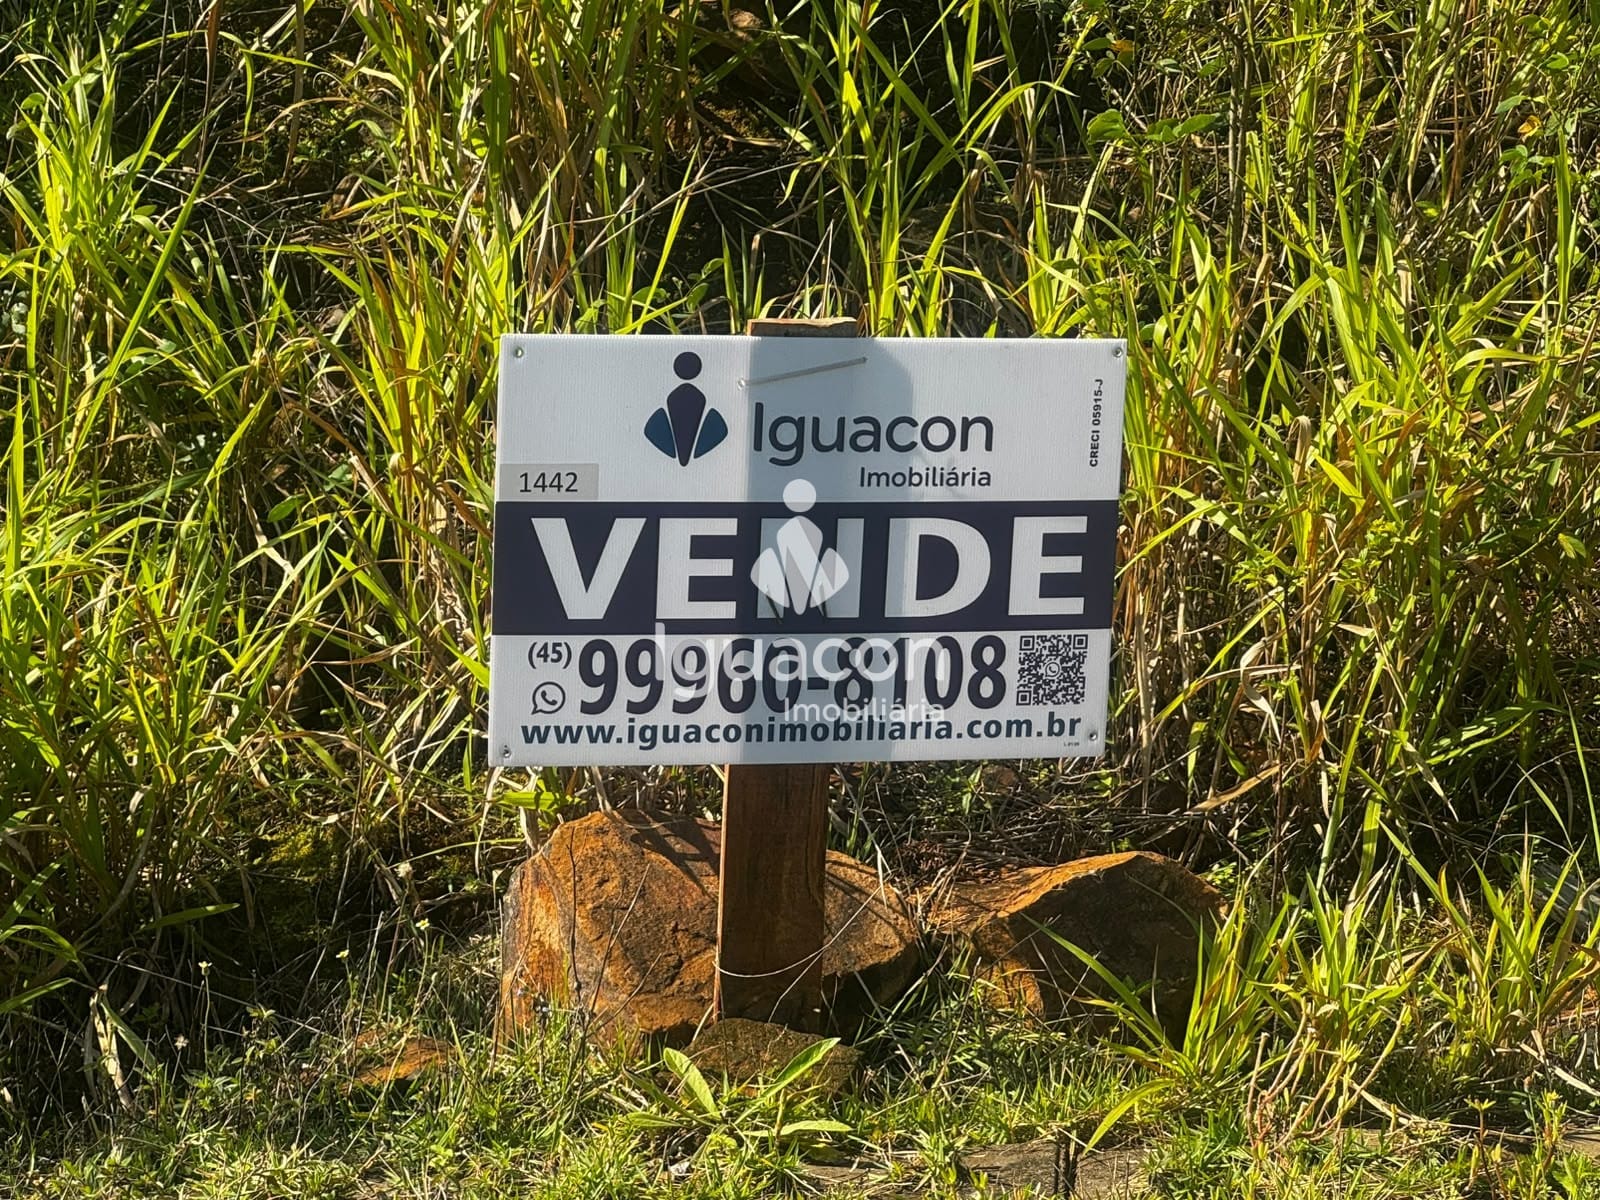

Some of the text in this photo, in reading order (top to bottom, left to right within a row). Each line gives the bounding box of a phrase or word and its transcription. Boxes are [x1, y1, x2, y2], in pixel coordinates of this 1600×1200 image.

[753, 402, 994, 466] Iguacon
[1089, 379, 1103, 467] CRECI 05915-J
[519, 472, 579, 493] 1442
[859, 467, 992, 487] Imobiliária
[531, 516, 1088, 619] VENDE
[528, 635, 1006, 715] (45) 99960-8108
[521, 712, 1081, 750] www.iguaconimobiliaria.com.br
